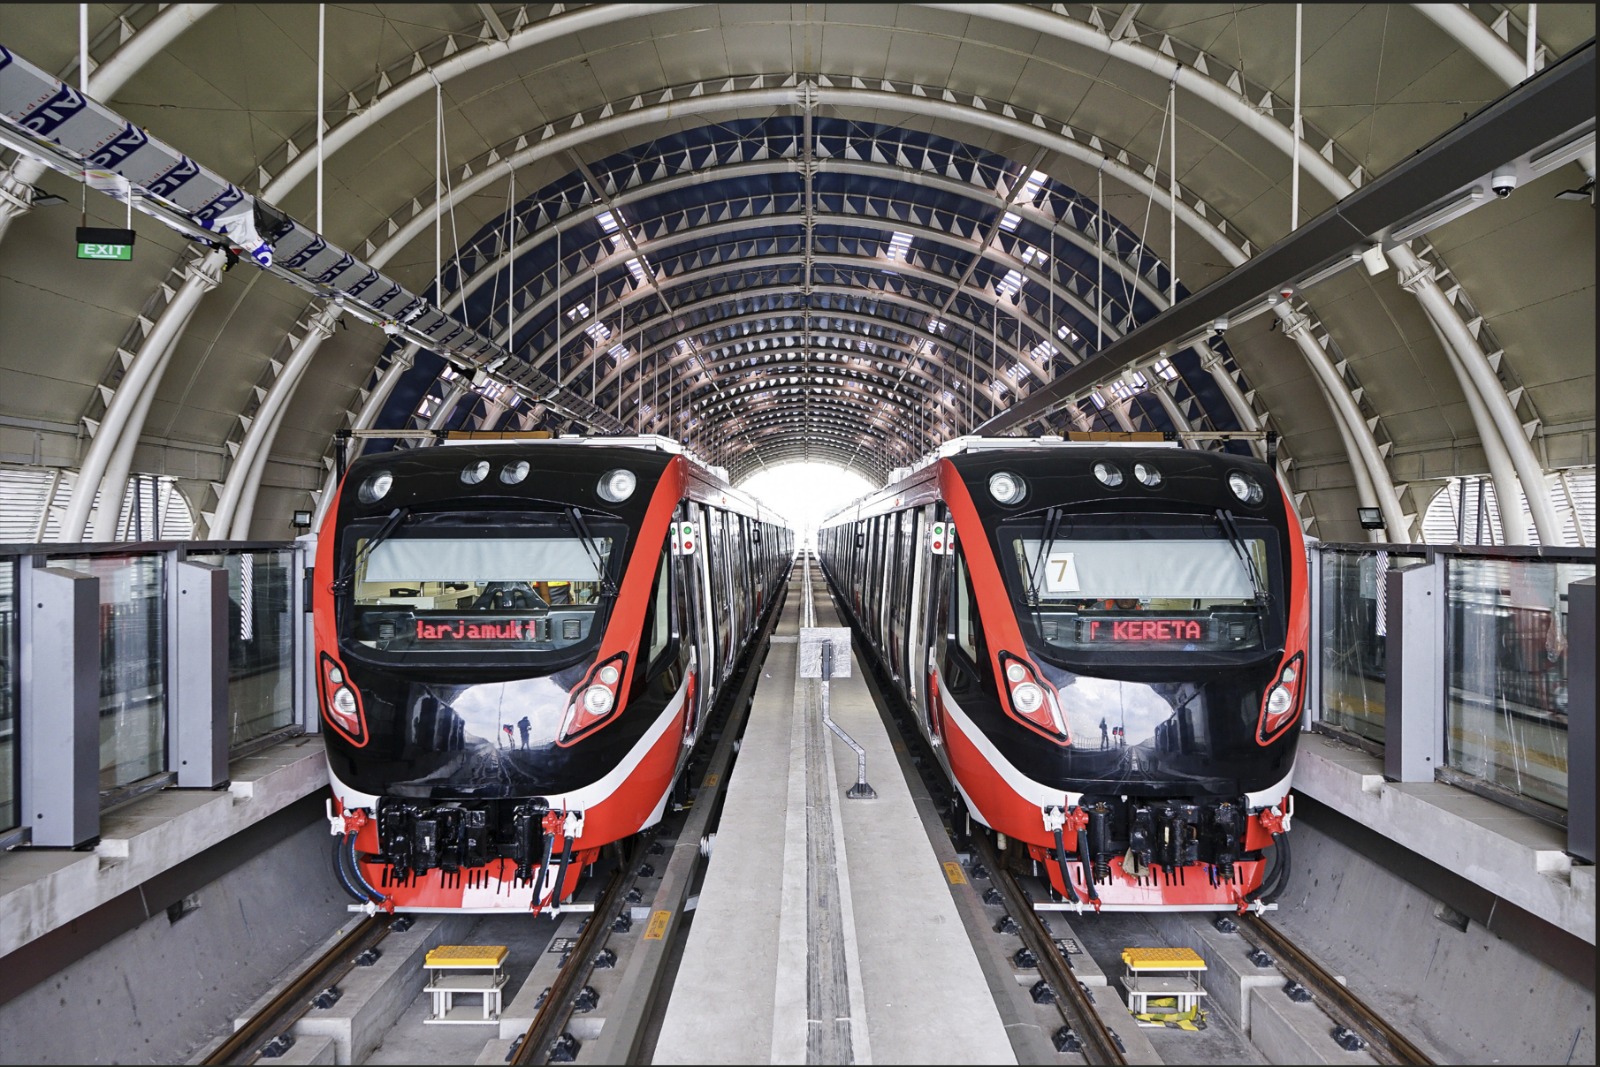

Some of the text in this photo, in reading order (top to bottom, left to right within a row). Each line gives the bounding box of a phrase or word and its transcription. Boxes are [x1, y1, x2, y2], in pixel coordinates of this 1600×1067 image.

[84, 243, 126, 255] EXIT
[1051, 560, 1067, 582] 7
[1113, 620, 1200, 640] KERETA
